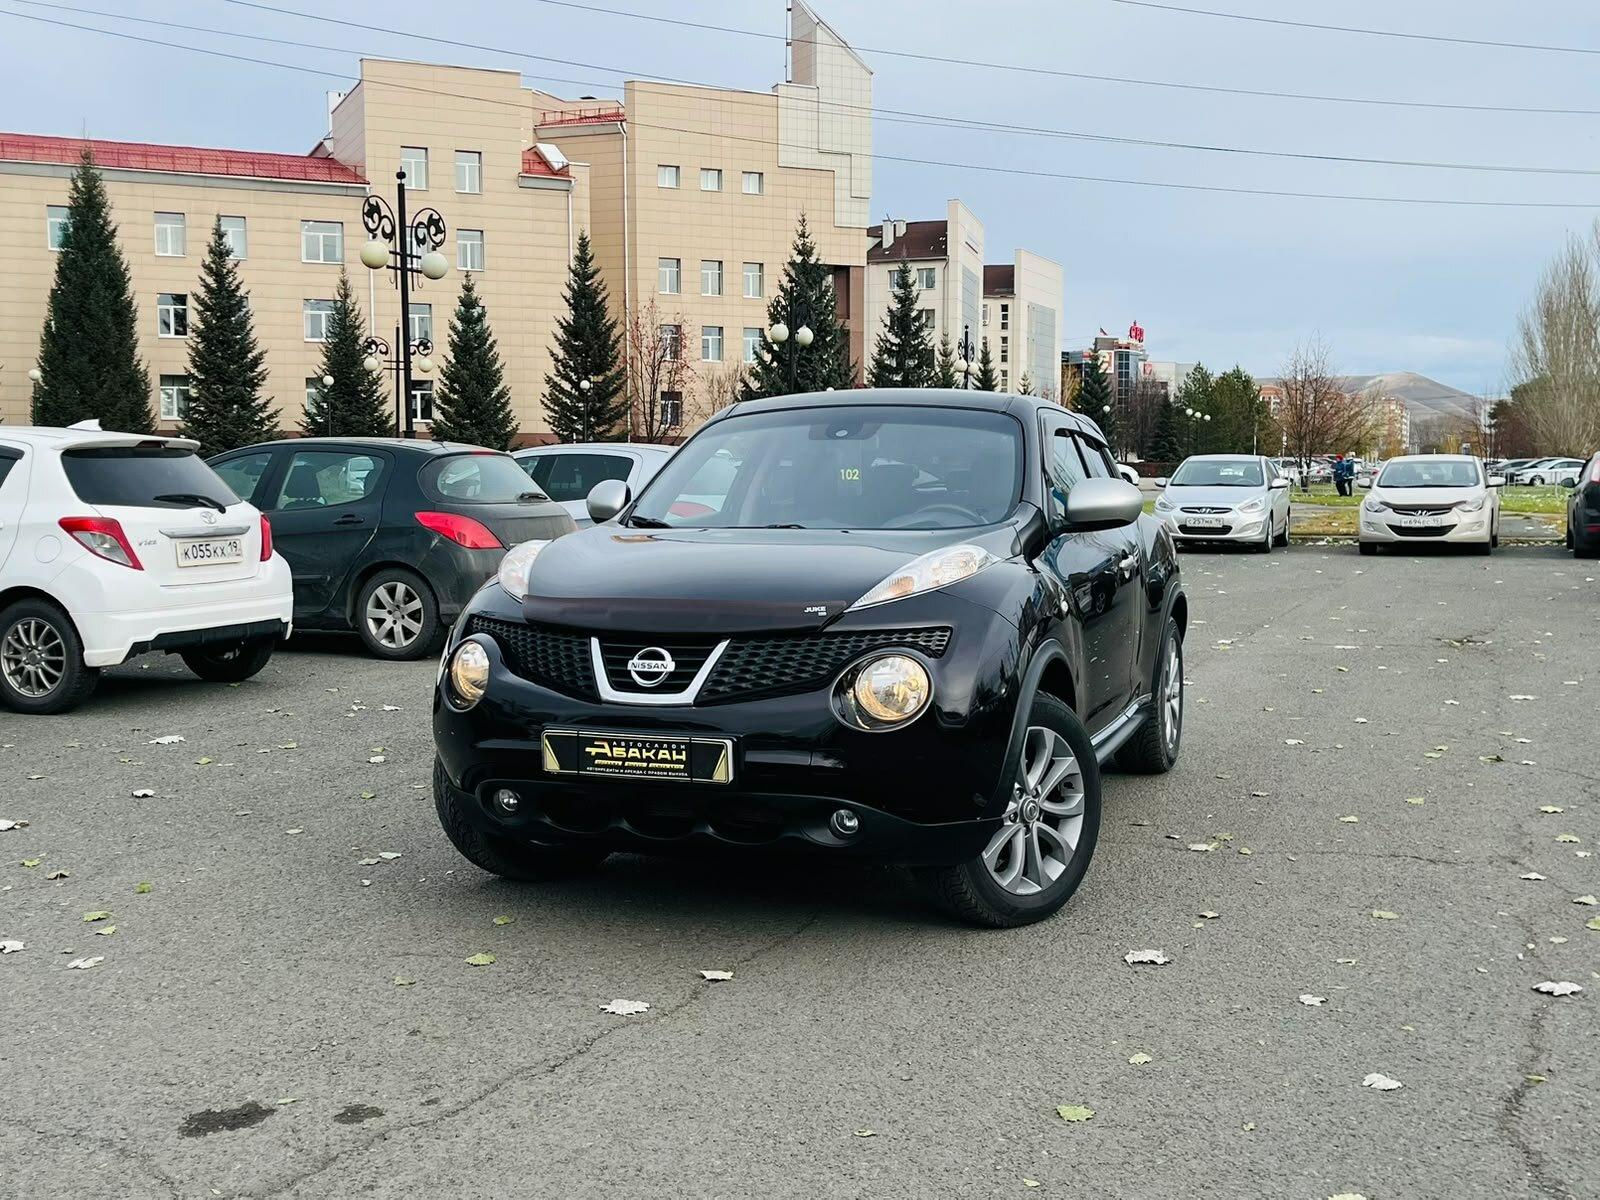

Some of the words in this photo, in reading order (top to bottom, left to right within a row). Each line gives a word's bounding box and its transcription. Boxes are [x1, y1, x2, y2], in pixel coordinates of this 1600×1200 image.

[840, 468, 860, 481] 102
[184, 544, 226, 560] К055КХ
[228, 541, 238, 553] 19
[631, 662, 668, 670] NISSAN
[612, 741, 686, 749] АВТОСАЛОН
